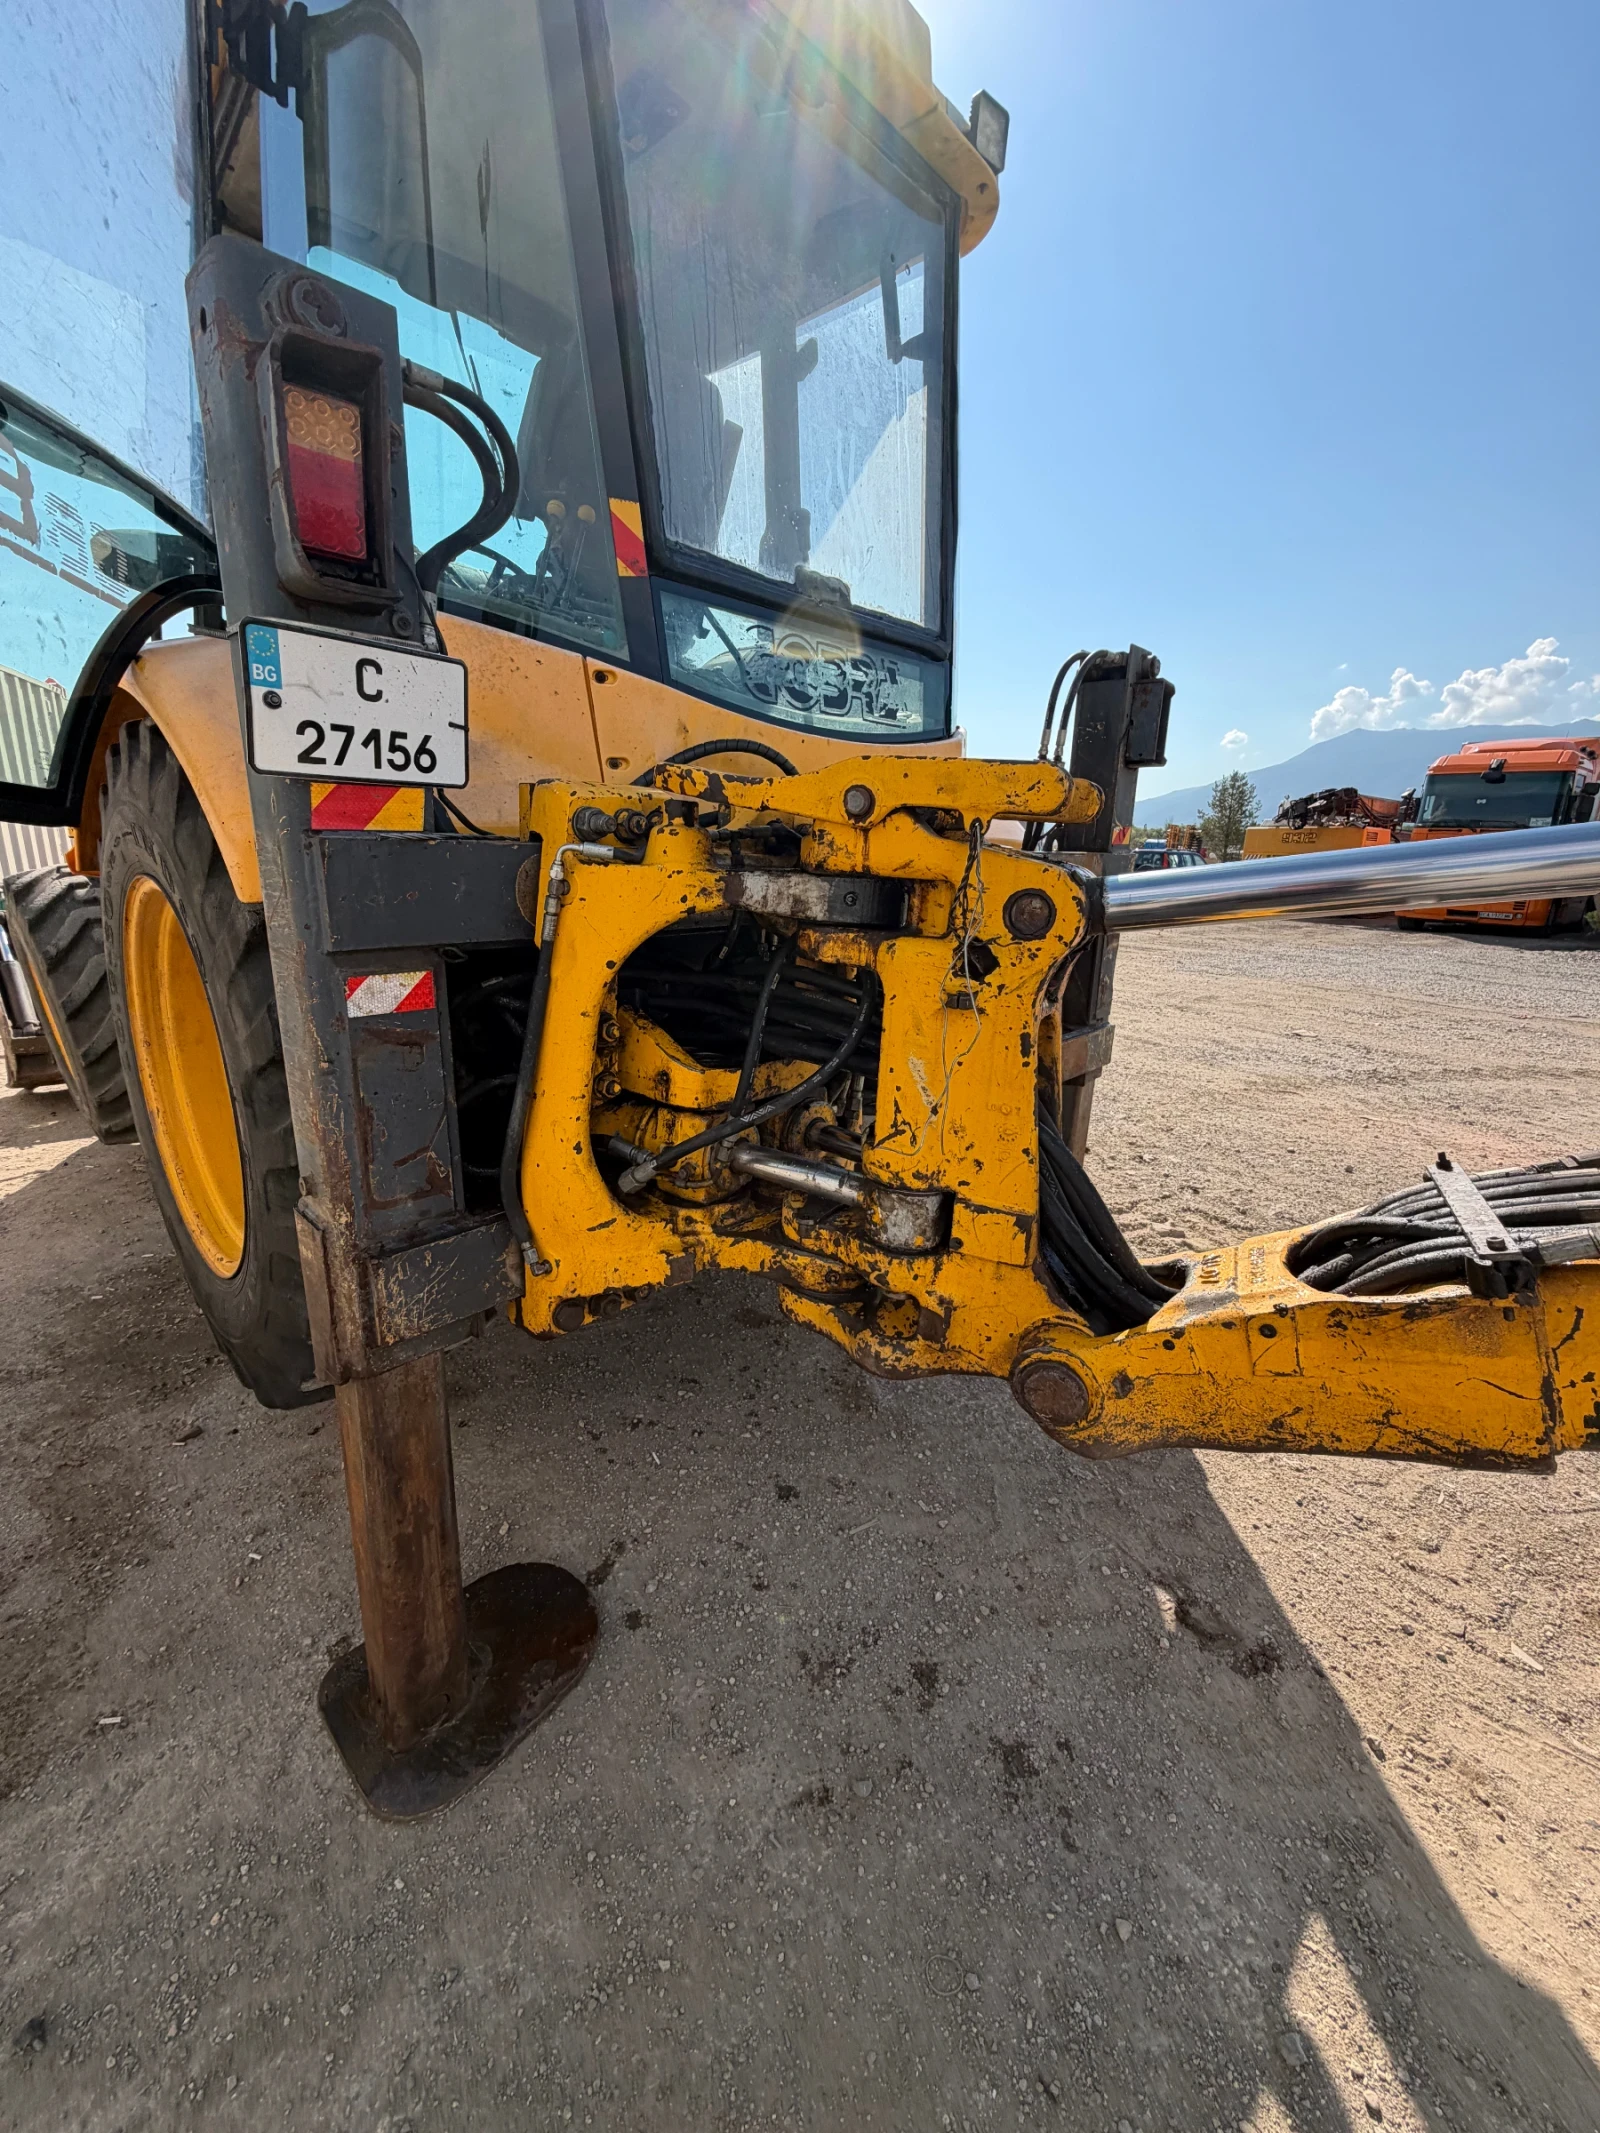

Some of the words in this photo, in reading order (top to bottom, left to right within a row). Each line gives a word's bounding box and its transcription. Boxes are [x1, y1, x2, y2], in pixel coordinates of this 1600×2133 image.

[252, 663, 278, 683] BG
[355, 658, 383, 703] C
[295, 719, 438, 775] 27156
[1281, 831, 1318, 844] 932
